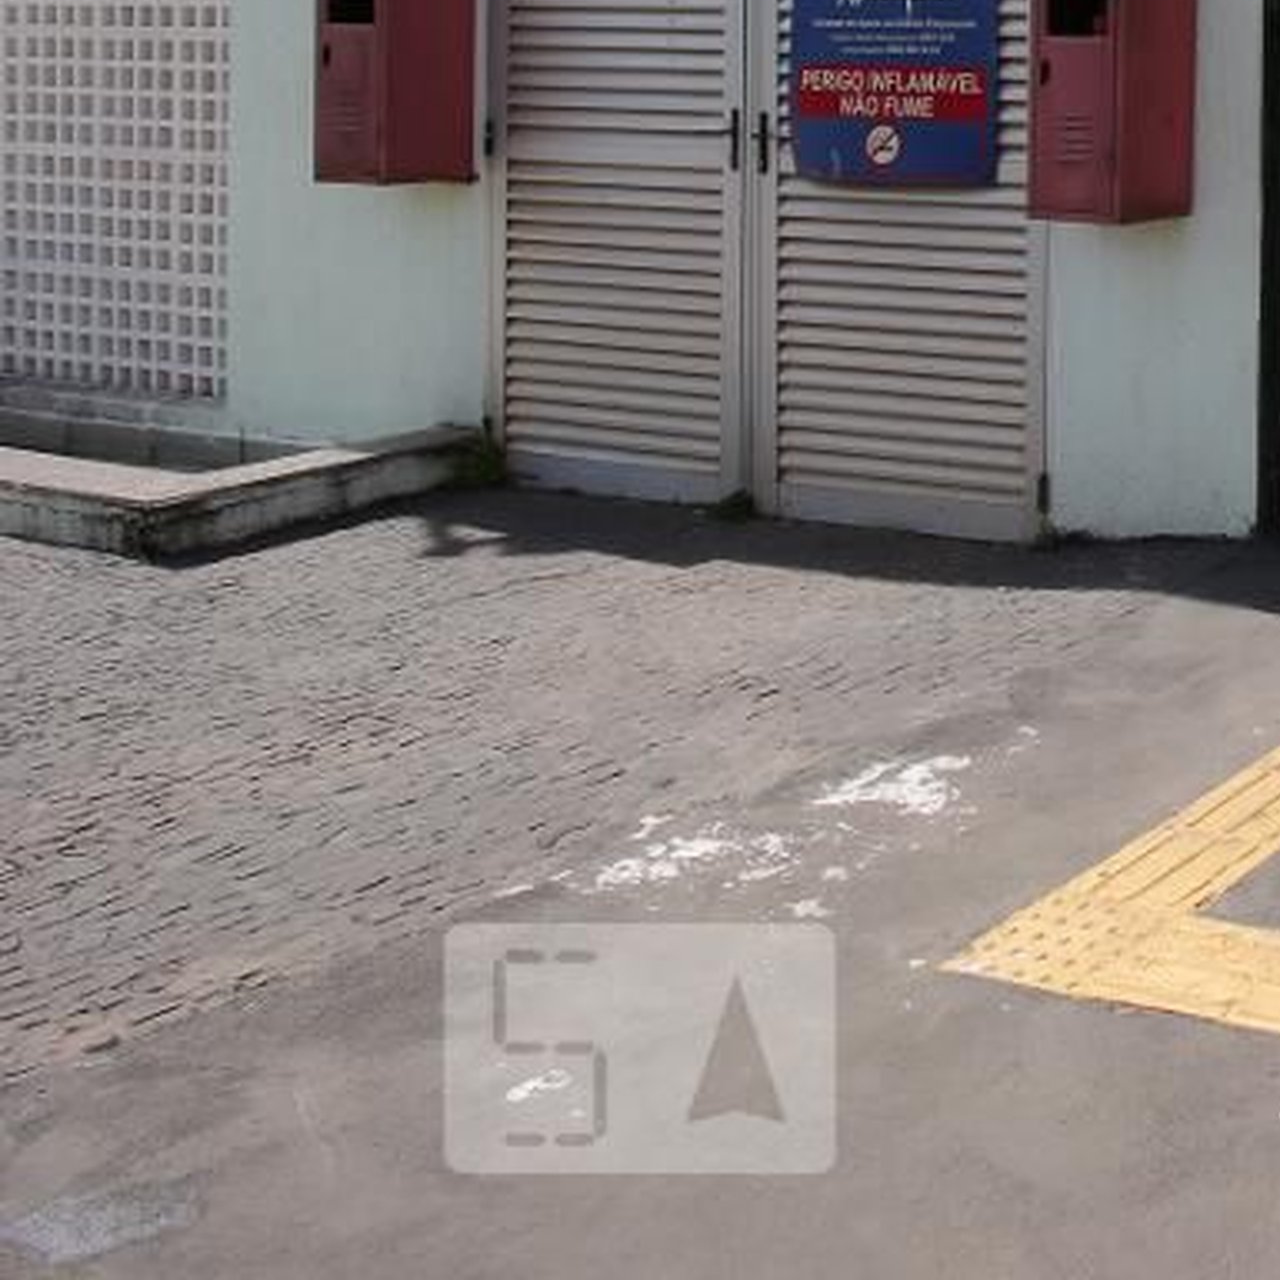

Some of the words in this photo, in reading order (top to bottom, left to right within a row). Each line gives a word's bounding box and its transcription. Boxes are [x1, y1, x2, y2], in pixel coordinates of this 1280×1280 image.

[801, 70, 864, 91] PERIGO
[839, 93, 878, 117] NÃO
[883, 96, 935, 118] FUME
